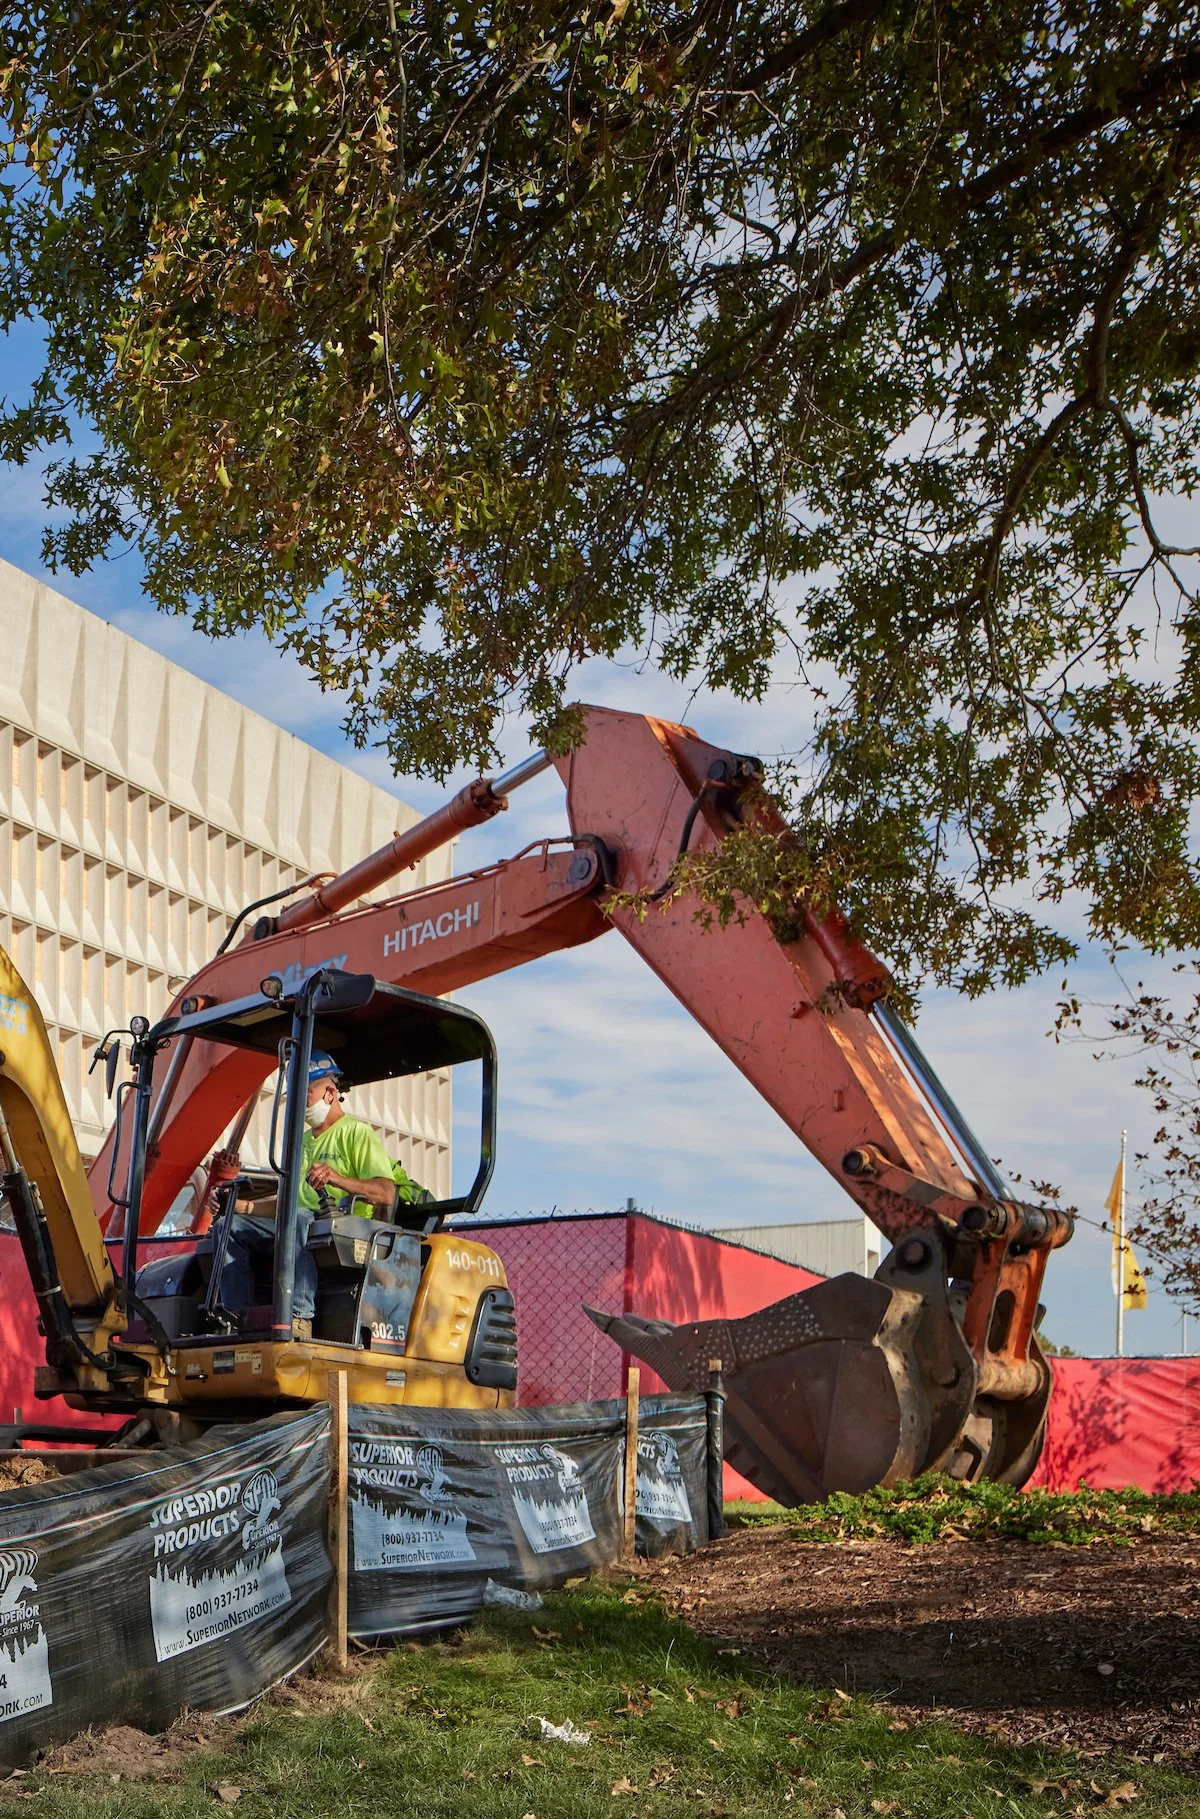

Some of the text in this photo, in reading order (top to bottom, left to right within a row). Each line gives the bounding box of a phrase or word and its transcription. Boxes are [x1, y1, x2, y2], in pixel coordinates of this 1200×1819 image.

[384, 901, 479, 957] HITACHI
[446, 1249, 500, 1277] 140-011
[371, 1322, 405, 1341] 302.5
[352, 1442, 414, 1466] SUPERIOR
[353, 1468, 419, 1488] PRODUCTS
[506, 1464, 555, 1484] PRODUCTS
[150, 1482, 242, 1528] SUPERIOR
[153, 1510, 240, 1557] PRODUCTS
[382, 1531, 445, 1547] (800) 937-7734
[185, 1578, 259, 1624] (800) 937-7734
[2, 1619, 35, 1638] Since 1967
